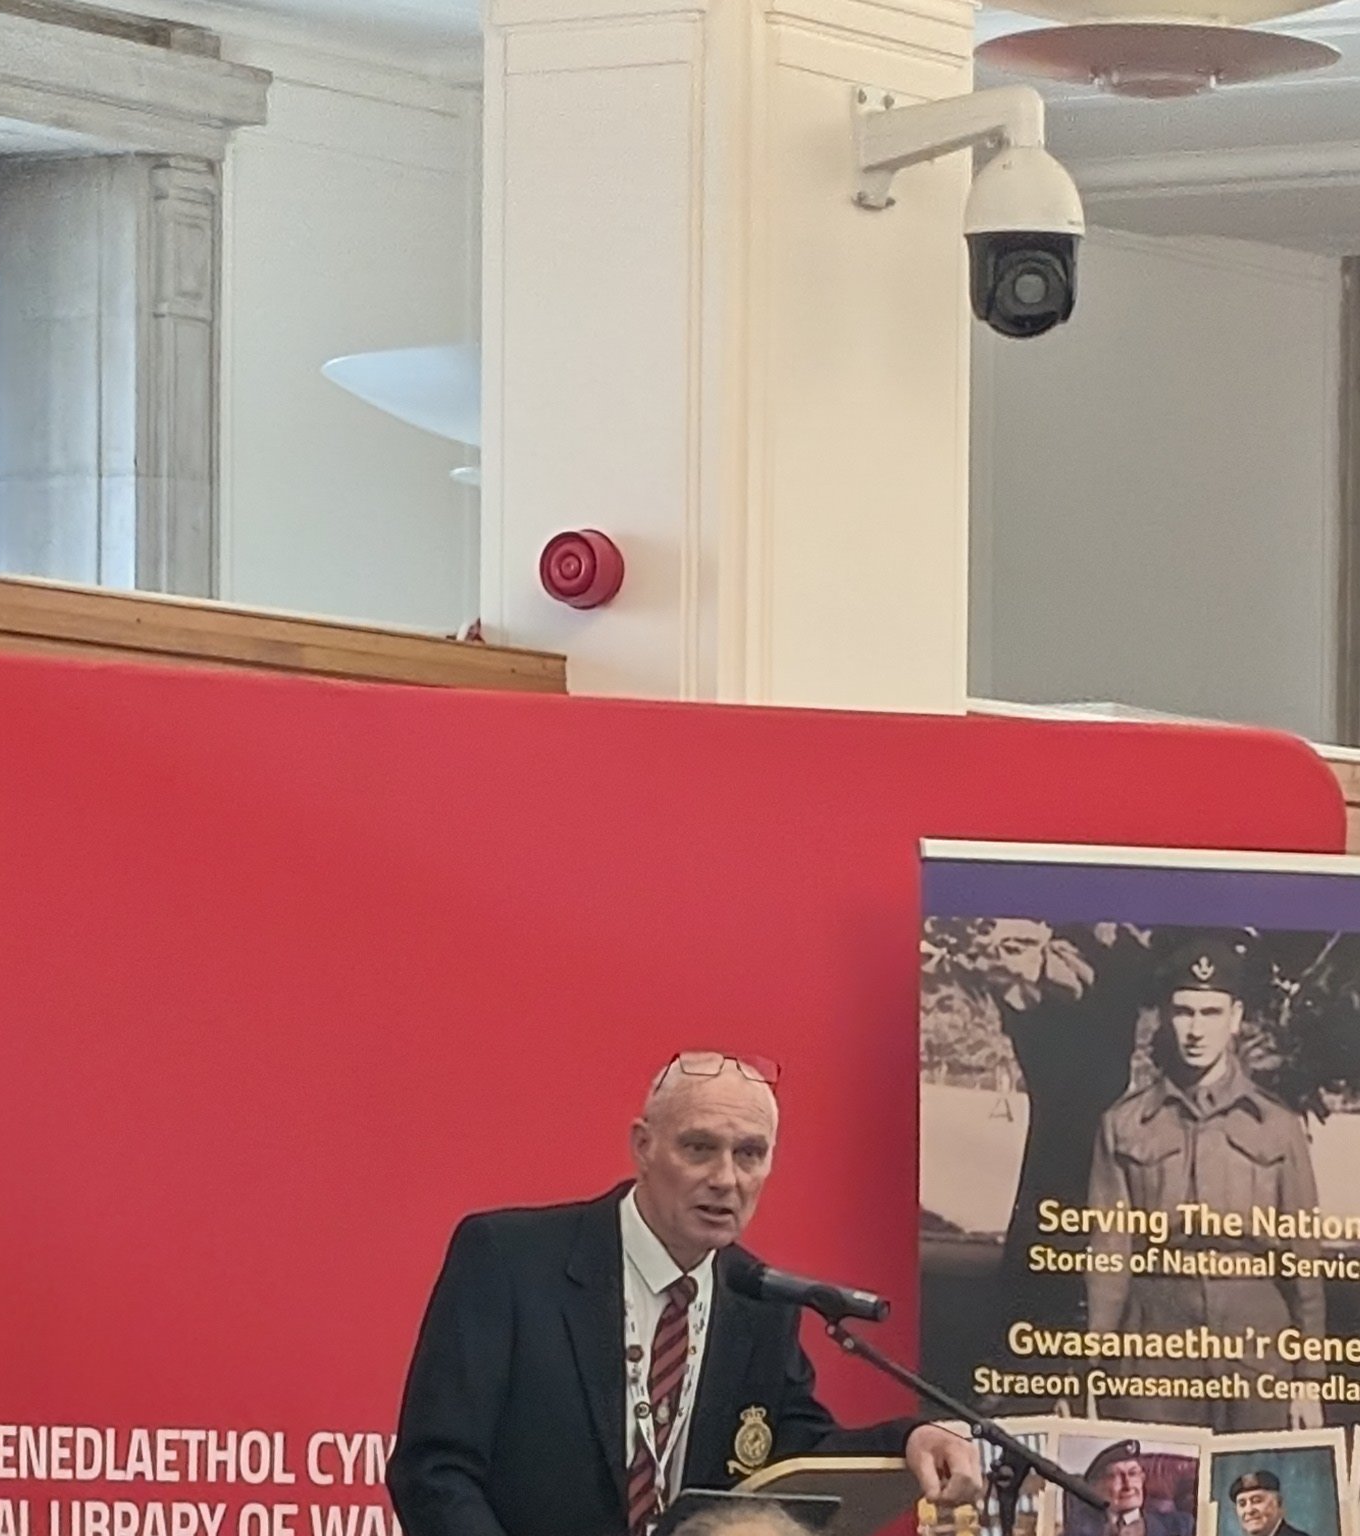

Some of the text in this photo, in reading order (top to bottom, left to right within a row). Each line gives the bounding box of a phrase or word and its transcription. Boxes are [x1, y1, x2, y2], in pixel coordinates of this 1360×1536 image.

[1038, 1199, 1168, 1244] Serving
[1177, 1203, 1242, 1238] The
[1029, 1245, 1123, 1273] Stories
[1129, 1246, 1161, 1274] of
[1163, 1249, 1276, 1279] National
[1008, 1321, 1271, 1361] Gwasanaethu'r
[973, 1366, 1080, 1396] Straeon
[1087, 1369, 1250, 1400] Gwasanaeth
